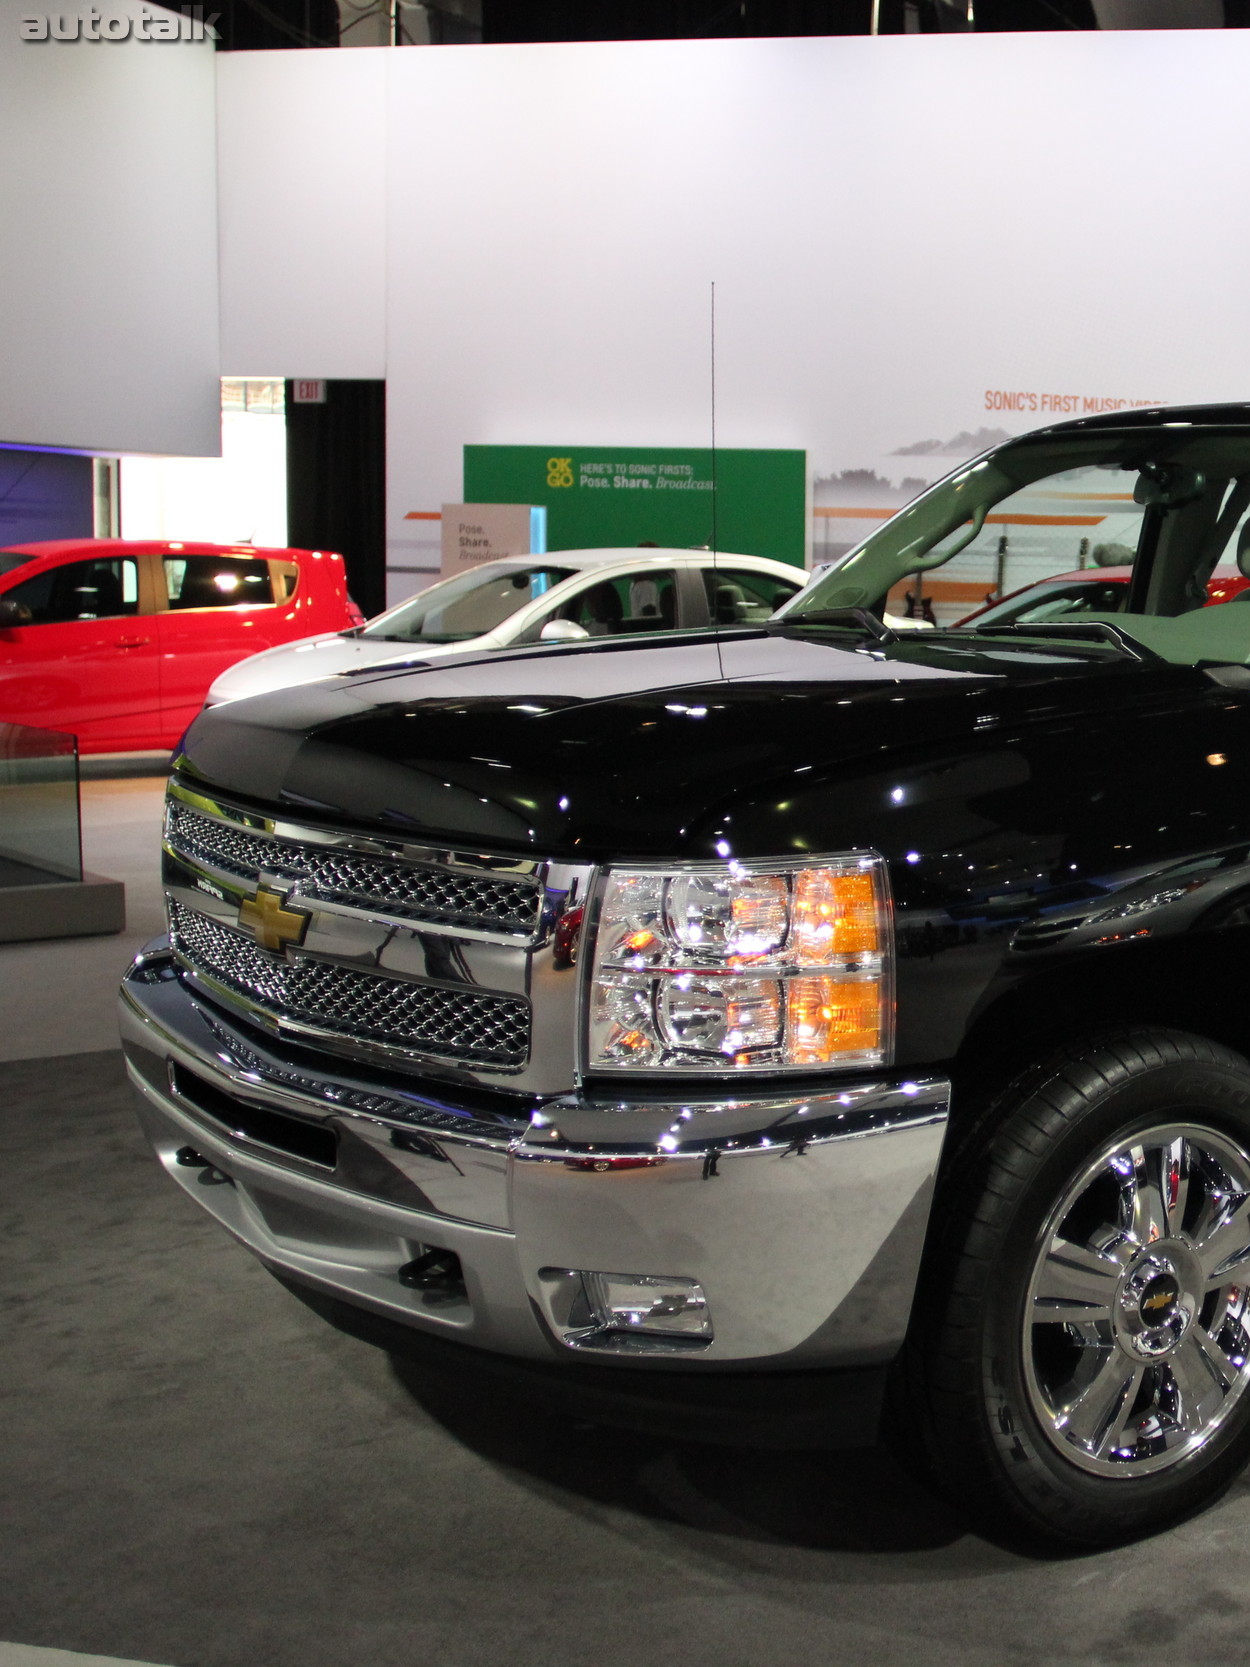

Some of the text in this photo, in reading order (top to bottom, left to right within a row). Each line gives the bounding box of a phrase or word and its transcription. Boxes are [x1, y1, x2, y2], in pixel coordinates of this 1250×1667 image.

[299, 382, 319, 399] EXIT
[984, 390, 1037, 411] SONIC'S
[1041, 394, 1080, 412] FIRST
[1082, 396, 1126, 412] MUSIC
[547, 458, 573, 473] OK
[580, 463, 613, 473] HERE'S
[615, 464, 627, 474] TO
[629, 464, 657, 474] SONIC
[547, 473, 574, 488] GO
[580, 475, 610, 488] Pose.
[613, 475, 652, 489] Share.
[459, 536, 492, 548] Share.
